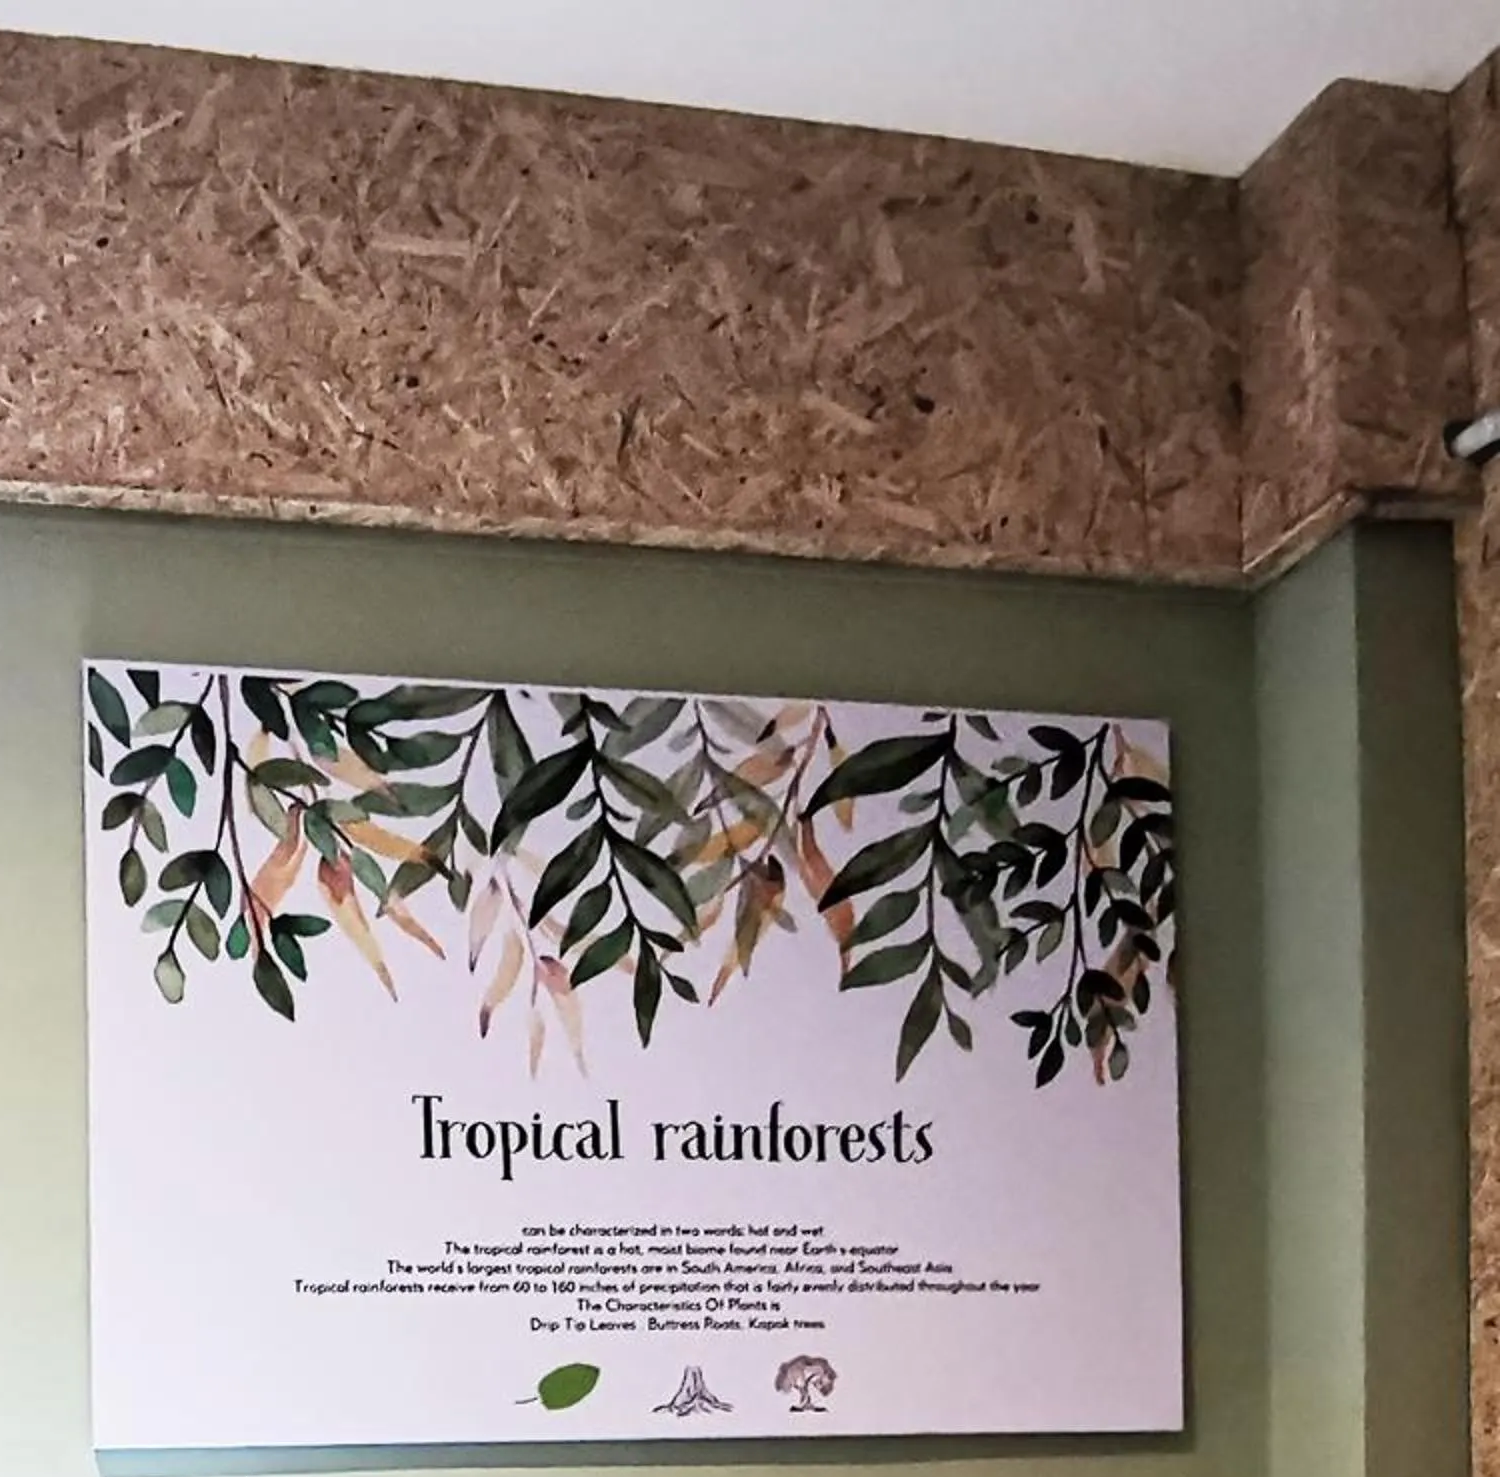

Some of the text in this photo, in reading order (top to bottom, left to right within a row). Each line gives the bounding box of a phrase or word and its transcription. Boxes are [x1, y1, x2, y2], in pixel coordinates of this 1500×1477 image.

[411, 1094, 934, 1182] Tropical rainforests
[521, 1226, 547, 1237] can
[548, 1223, 567, 1238] be
[568, 1223, 658, 1237] characterized
[659, 1226, 674, 1237] in
[675, 1225, 701, 1238] two
[747, 1223, 770, 1238] hot
[771, 1223, 799, 1238] and
[444, 1240, 472, 1256] The
[473, 1241, 524, 1258] tropical
[526, 1241, 591, 1257] rainforest
[592, 1245, 605, 1257] is
[605, 1245, 618, 1257] a
[647, 1243, 684, 1256] moist
[684, 1242, 727, 1257] biome
[728, 1240, 768, 1257] found
[768, 1245, 799, 1257] near
[387, 1259, 414, 1275] The
[465, 1260, 513, 1277] largest
[515, 1261, 566, 1277] tropical
[567, 1260, 639, 1276] rainforests
[639, 1264, 664, 1275] are
[665, 1263, 679, 1274] in
[680, 1259, 722, 1276] South
[829, 1259, 856, 1275] and
[856, 1259, 922, 1275] Southeast
[294, 1278, 351, 1297] Tropical
[352, 1279, 425, 1295] rainforests
[427, 1283, 477, 1294] receive
[478, 1279, 511, 1294] from
[512, 1279, 532, 1294] 60
[532, 1282, 549, 1294] to
[551, 1279, 577, 1295] 160
[578, 1279, 620, 1295] inches
[621, 1279, 636, 1294] of
[638, 1281, 722, 1296] precipitation
[722, 1278, 750, 1295] that
[752, 1283, 764, 1294] is
[846, 1278, 915, 1294] distributed
[989, 1279, 1011, 1293] the
[576, 1297, 603, 1313] The
[604, 1297, 703, 1313] Characteristics
[727, 1296, 769, 1312] Plants
[769, 1301, 781, 1313] is
[529, 1316, 561, 1333] Drip
[647, 1315, 701, 1332] Buttress
[747, 1316, 790, 1332] Kapok
